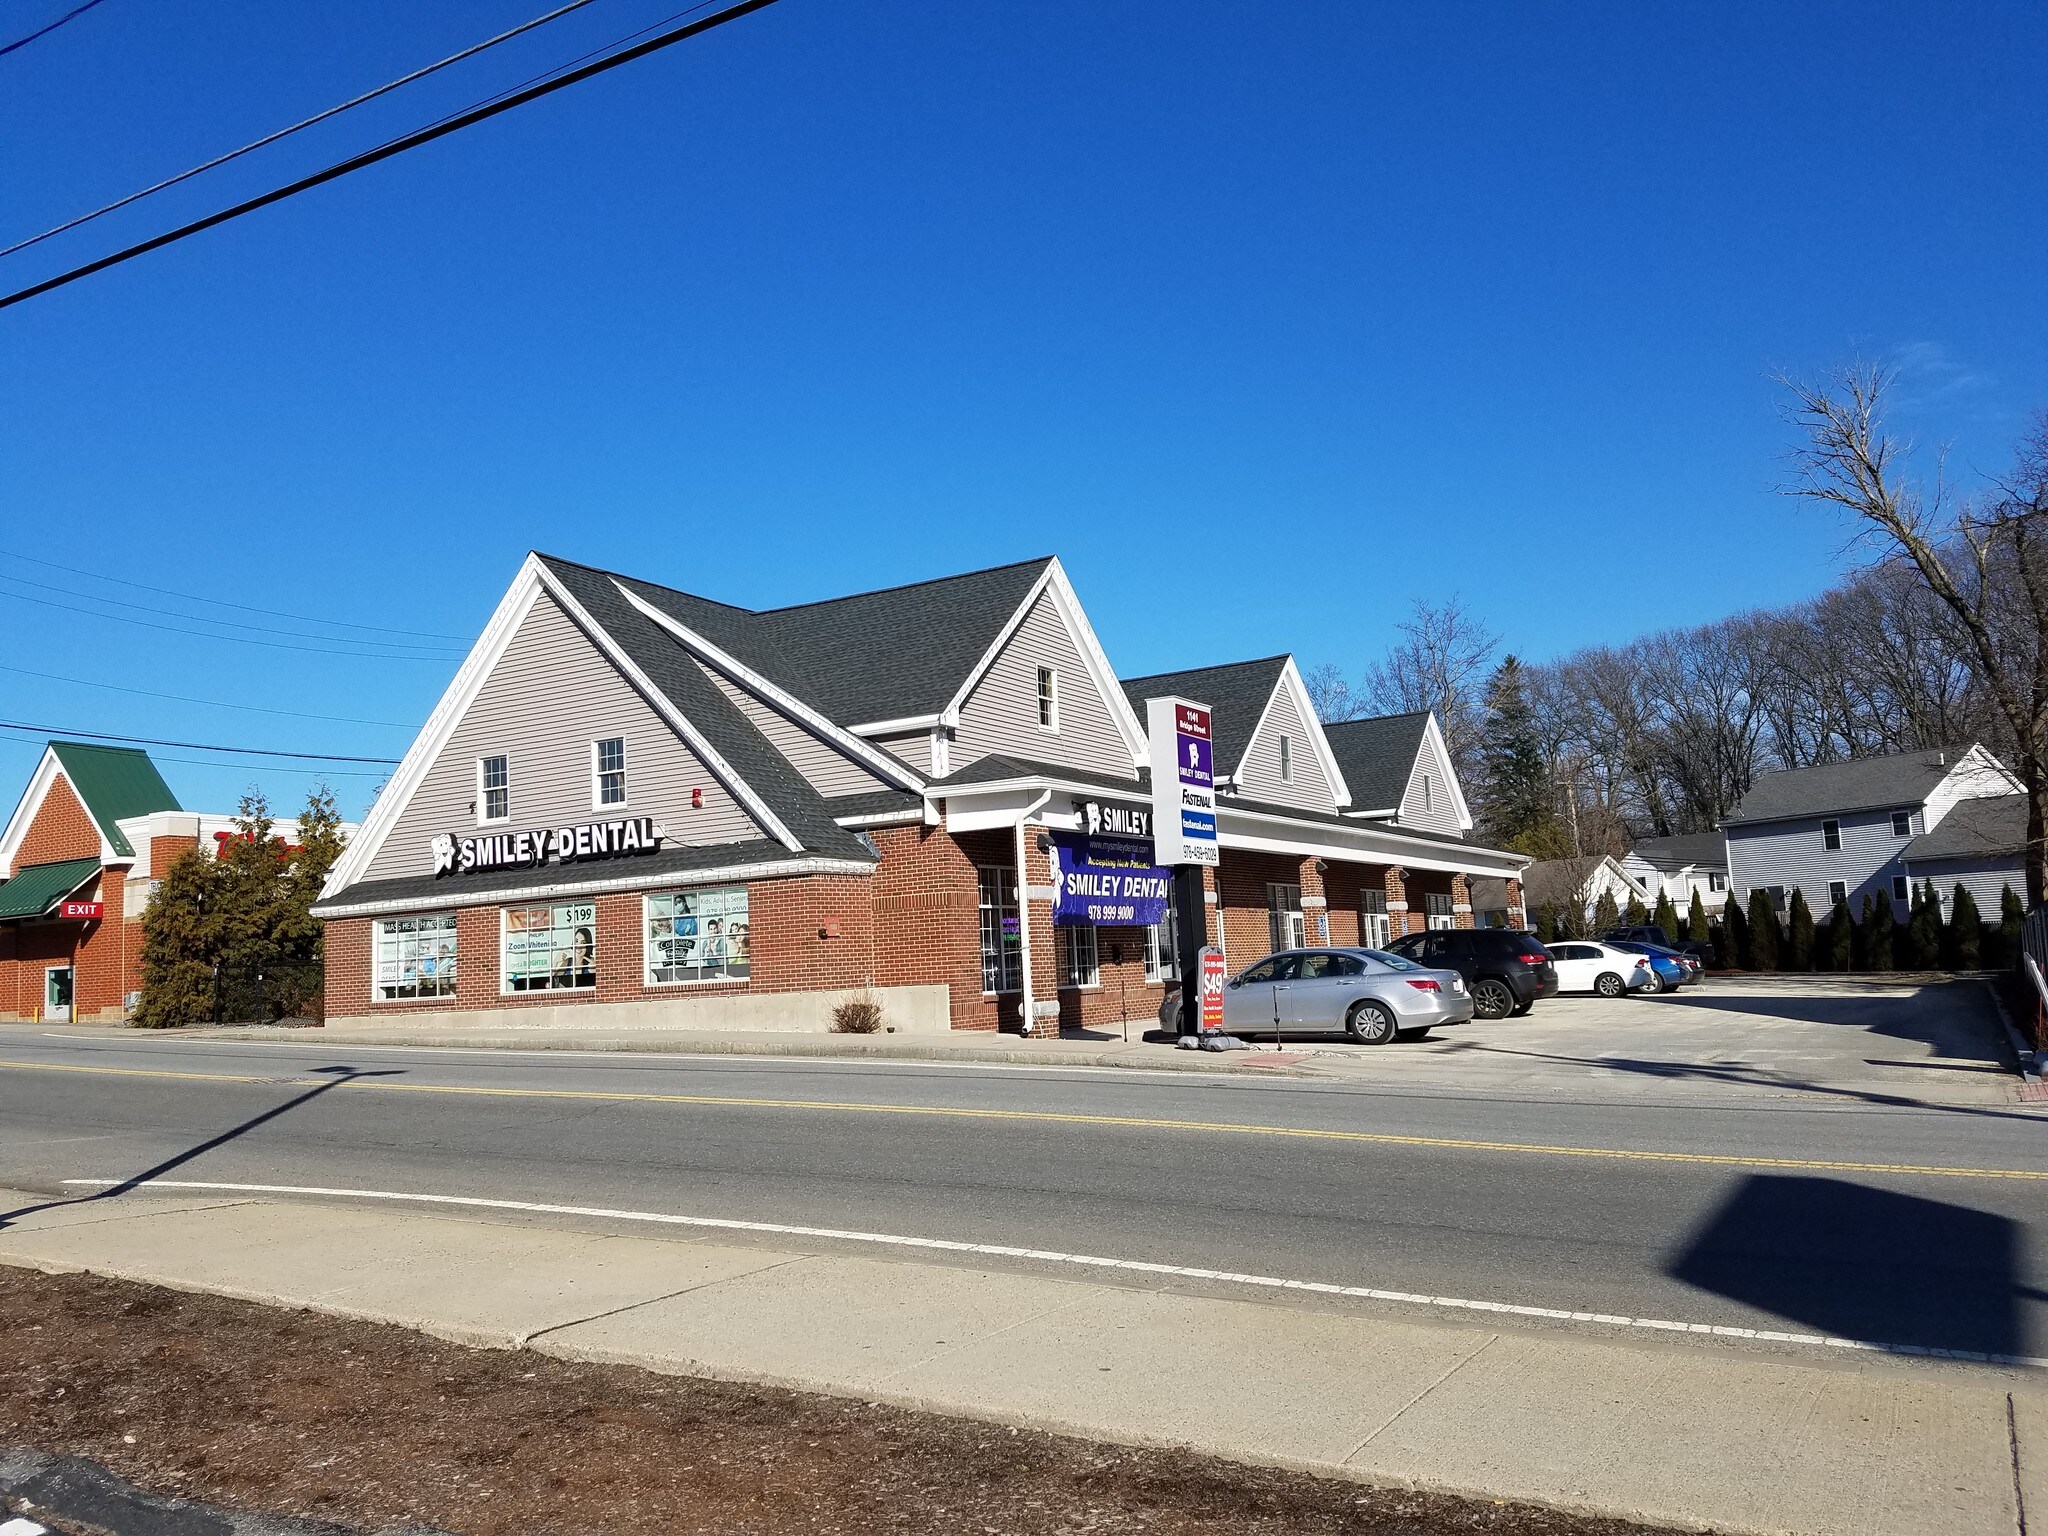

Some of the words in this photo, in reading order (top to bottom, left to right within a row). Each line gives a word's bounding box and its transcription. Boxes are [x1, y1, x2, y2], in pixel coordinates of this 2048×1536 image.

[1179, 766, 1194, 778] SMILEY
[1194, 770, 1211, 781] DENTAL
[1103, 807, 1147, 835] SMILEY
[461, 830, 548, 868] SMILEY
[558, 818, 654, 857] DENTAL
[1087, 856, 1116, 869] Accepting
[1116, 859, 1129, 868] New
[1130, 859, 1151, 870] Patients
[1067, 873, 1121, 897] SMILEY
[67, 904, 97, 915] EXIT
[1088, 904, 1102, 920] 978
[1102, 905, 1117, 920] 999
[1118, 905, 1134, 920] 9000
[1203, 970, 1222, 997] $49
